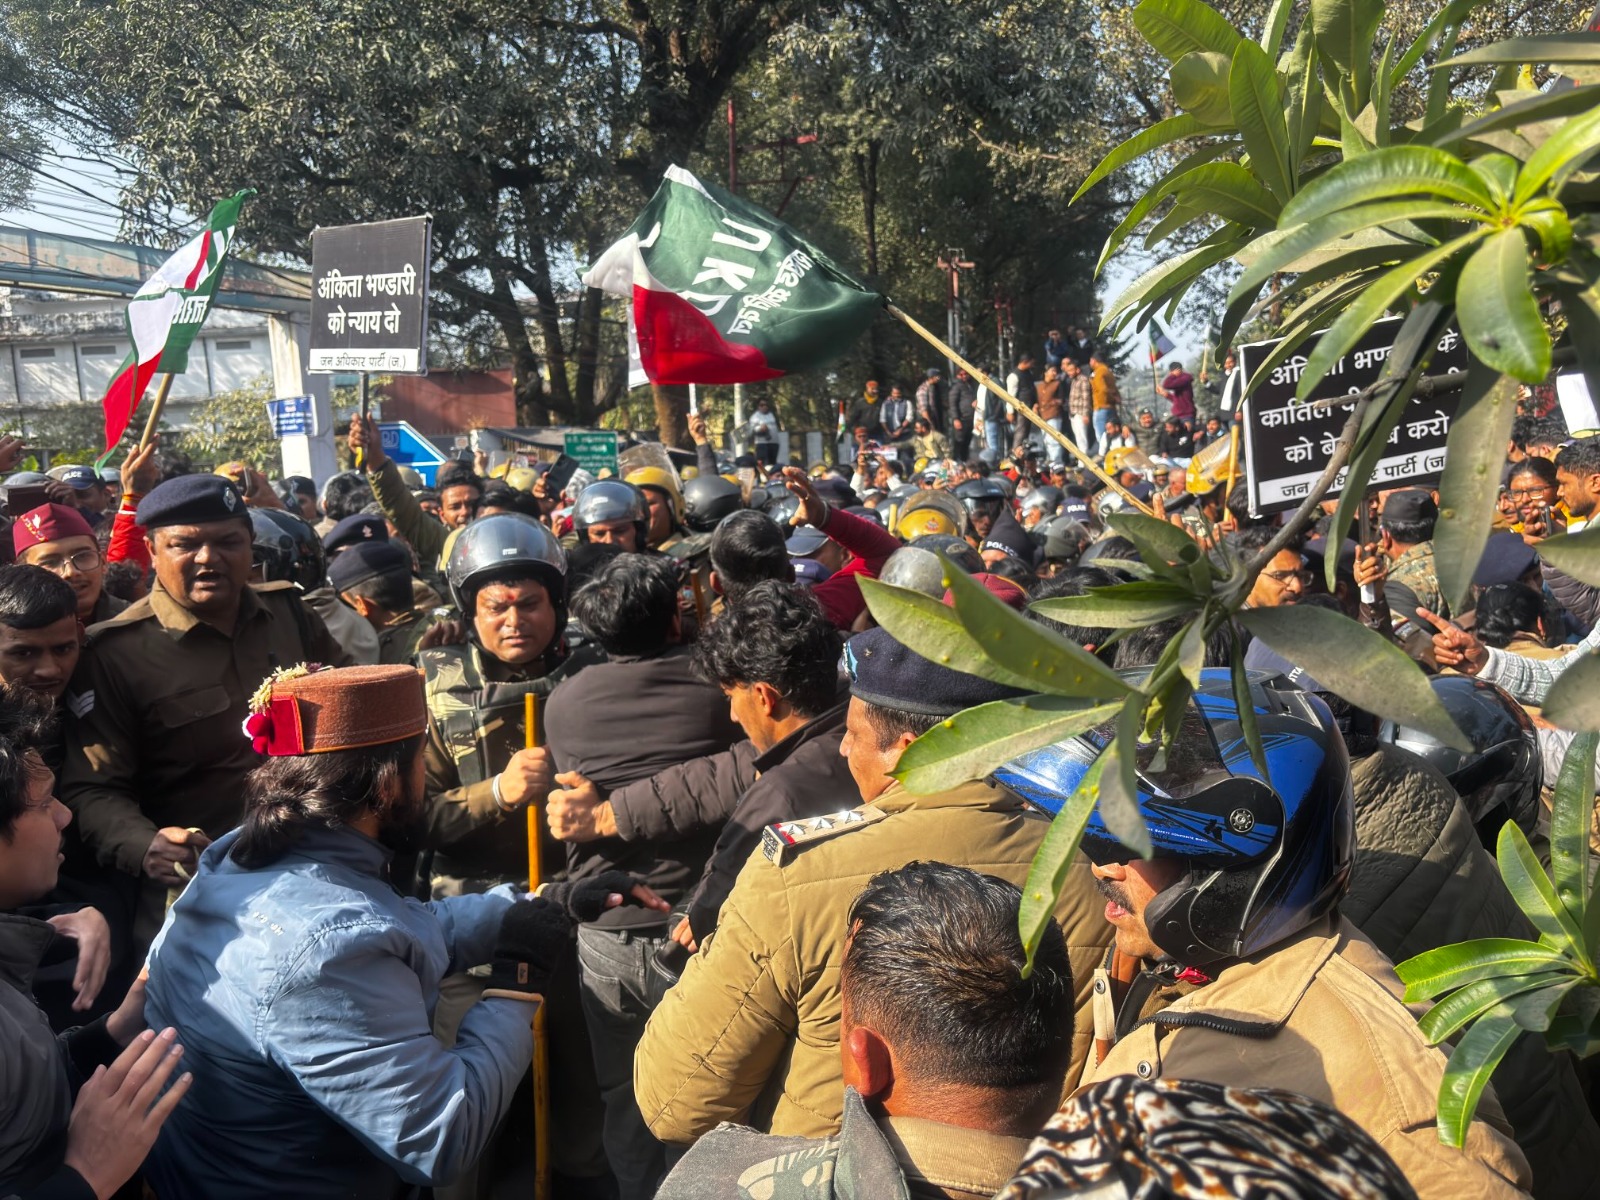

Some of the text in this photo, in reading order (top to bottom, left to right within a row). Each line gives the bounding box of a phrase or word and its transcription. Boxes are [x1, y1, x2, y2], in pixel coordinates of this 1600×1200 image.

[318, 263, 416, 299] अंकिता भण्डारी
[328, 302, 401, 335] को न्याय दो
[320, 356, 333, 367] जन
[369, 352, 386, 367] पार्टी
[1284, 436, 1314, 463] को
[1407, 410, 1450, 440] करो
[1281, 482, 1309, 497] जन
[1383, 455, 1417, 477] पार्टी
